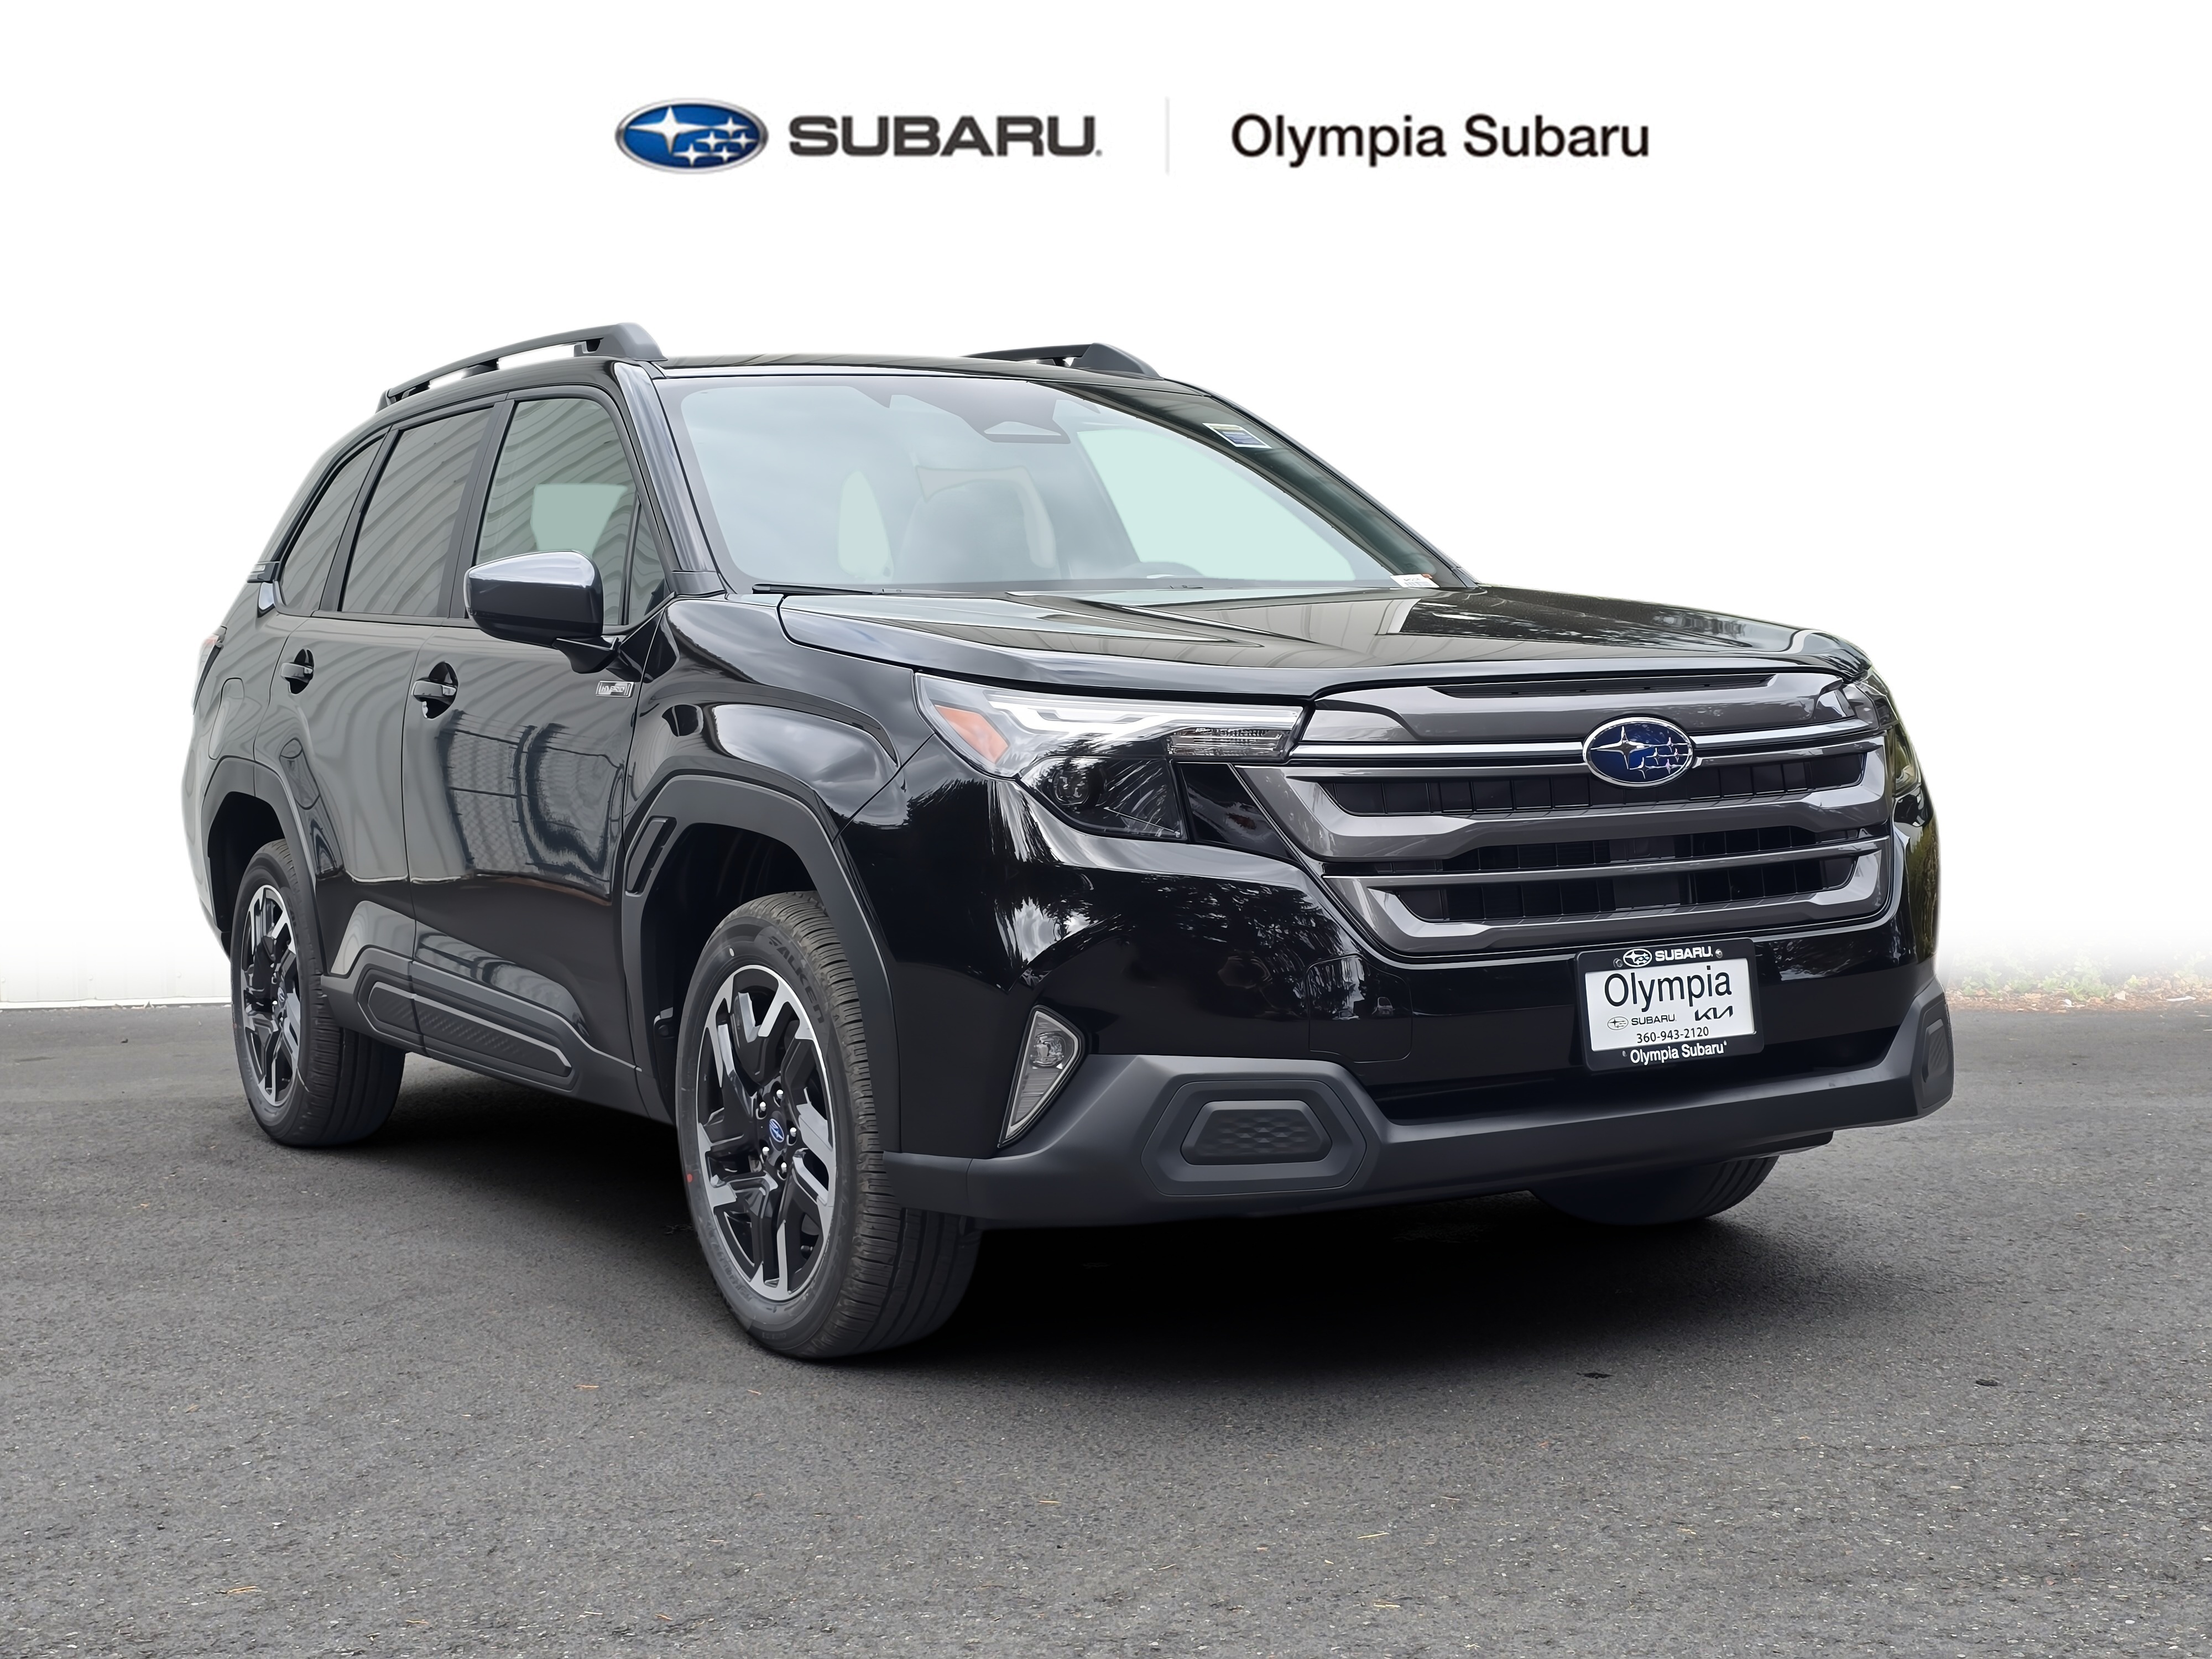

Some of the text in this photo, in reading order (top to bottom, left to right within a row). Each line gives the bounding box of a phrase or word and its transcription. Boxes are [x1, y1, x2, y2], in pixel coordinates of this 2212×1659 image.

[1655, 946, 1712, 962] SUBARU
[1604, 965, 1732, 1013] Olympia
[1631, 1014, 1676, 1026] SUBARU
[1636, 1026, 1709, 1044] 360-943-2120
[1630, 1042, 1724, 1066] Olympia Subaru
